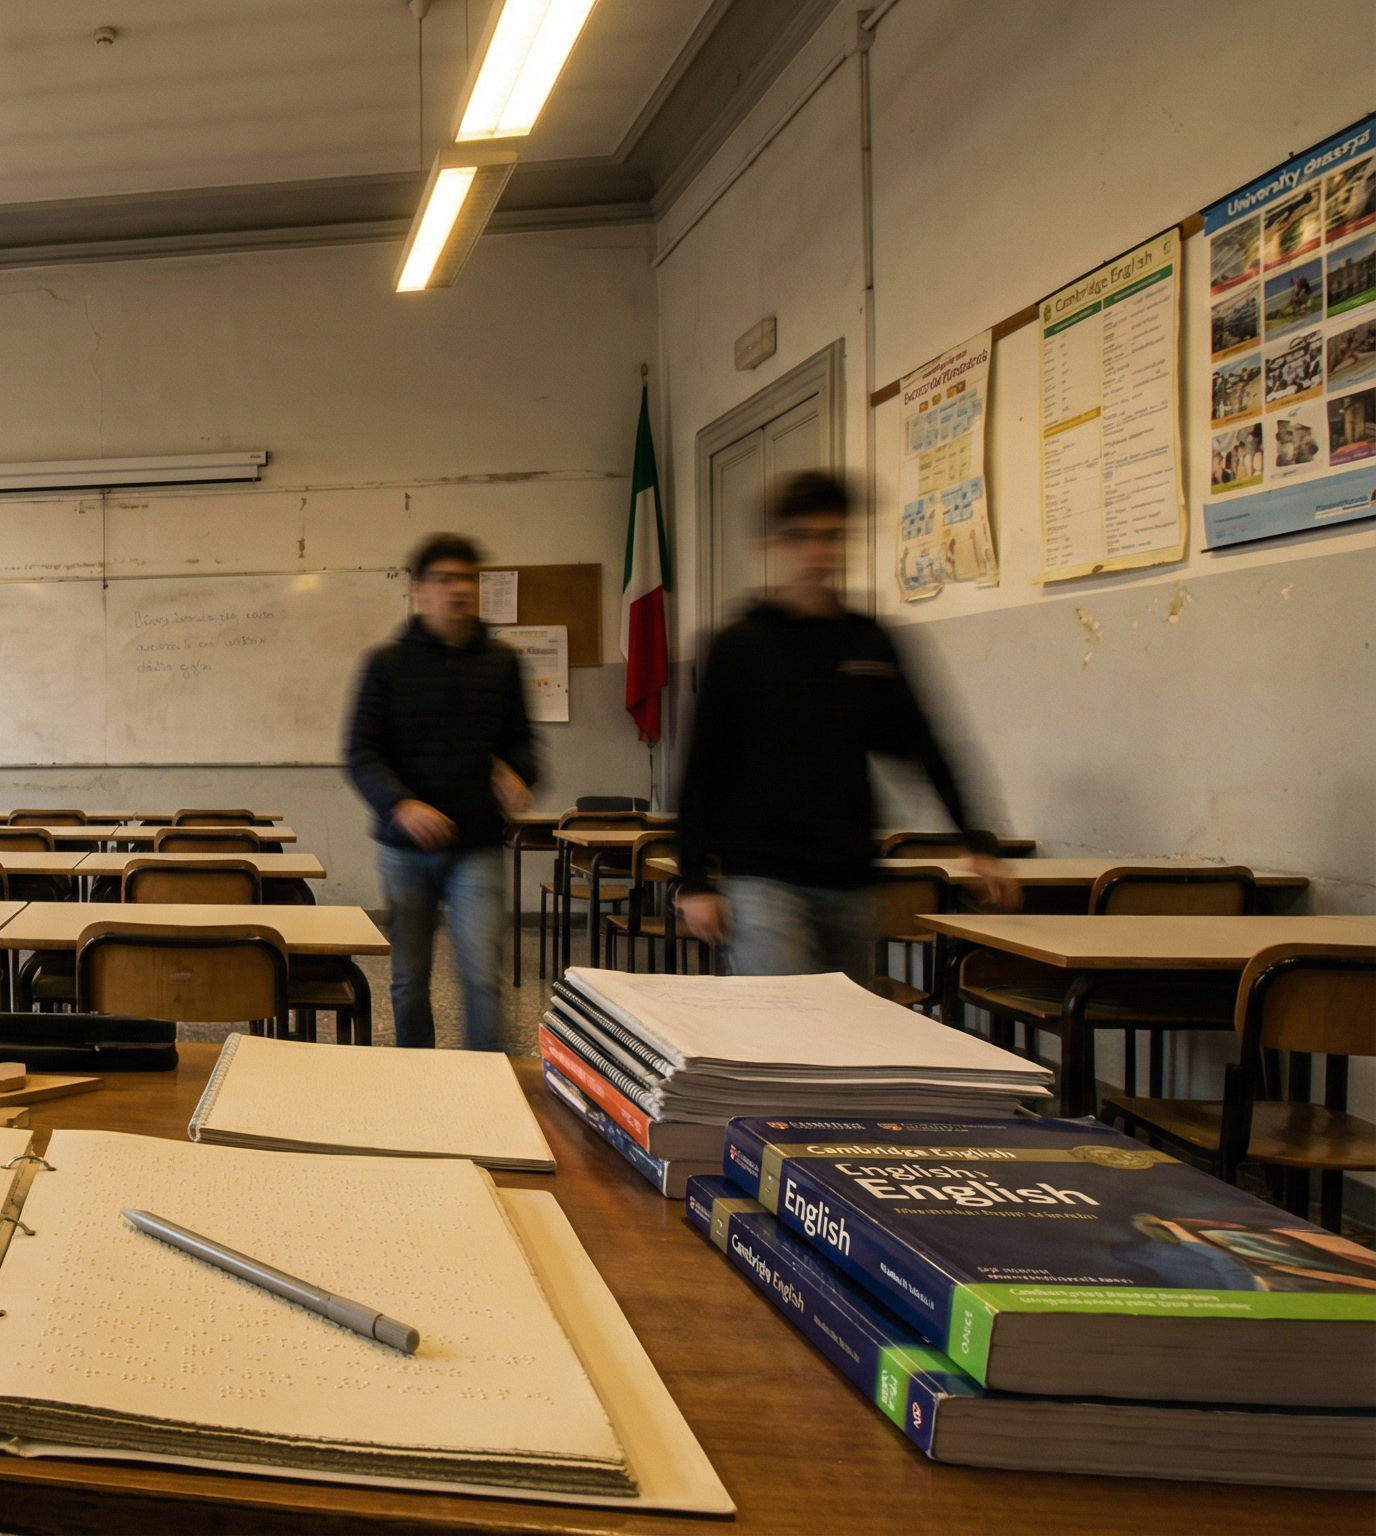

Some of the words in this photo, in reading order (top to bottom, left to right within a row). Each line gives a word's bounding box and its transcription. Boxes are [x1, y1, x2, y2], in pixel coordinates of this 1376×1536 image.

[806, 1145, 929, 1159] Cambridge
[929, 1148, 1017, 1160] English
[854, 1177, 1101, 1207] English
[784, 1178, 850, 1256] English
